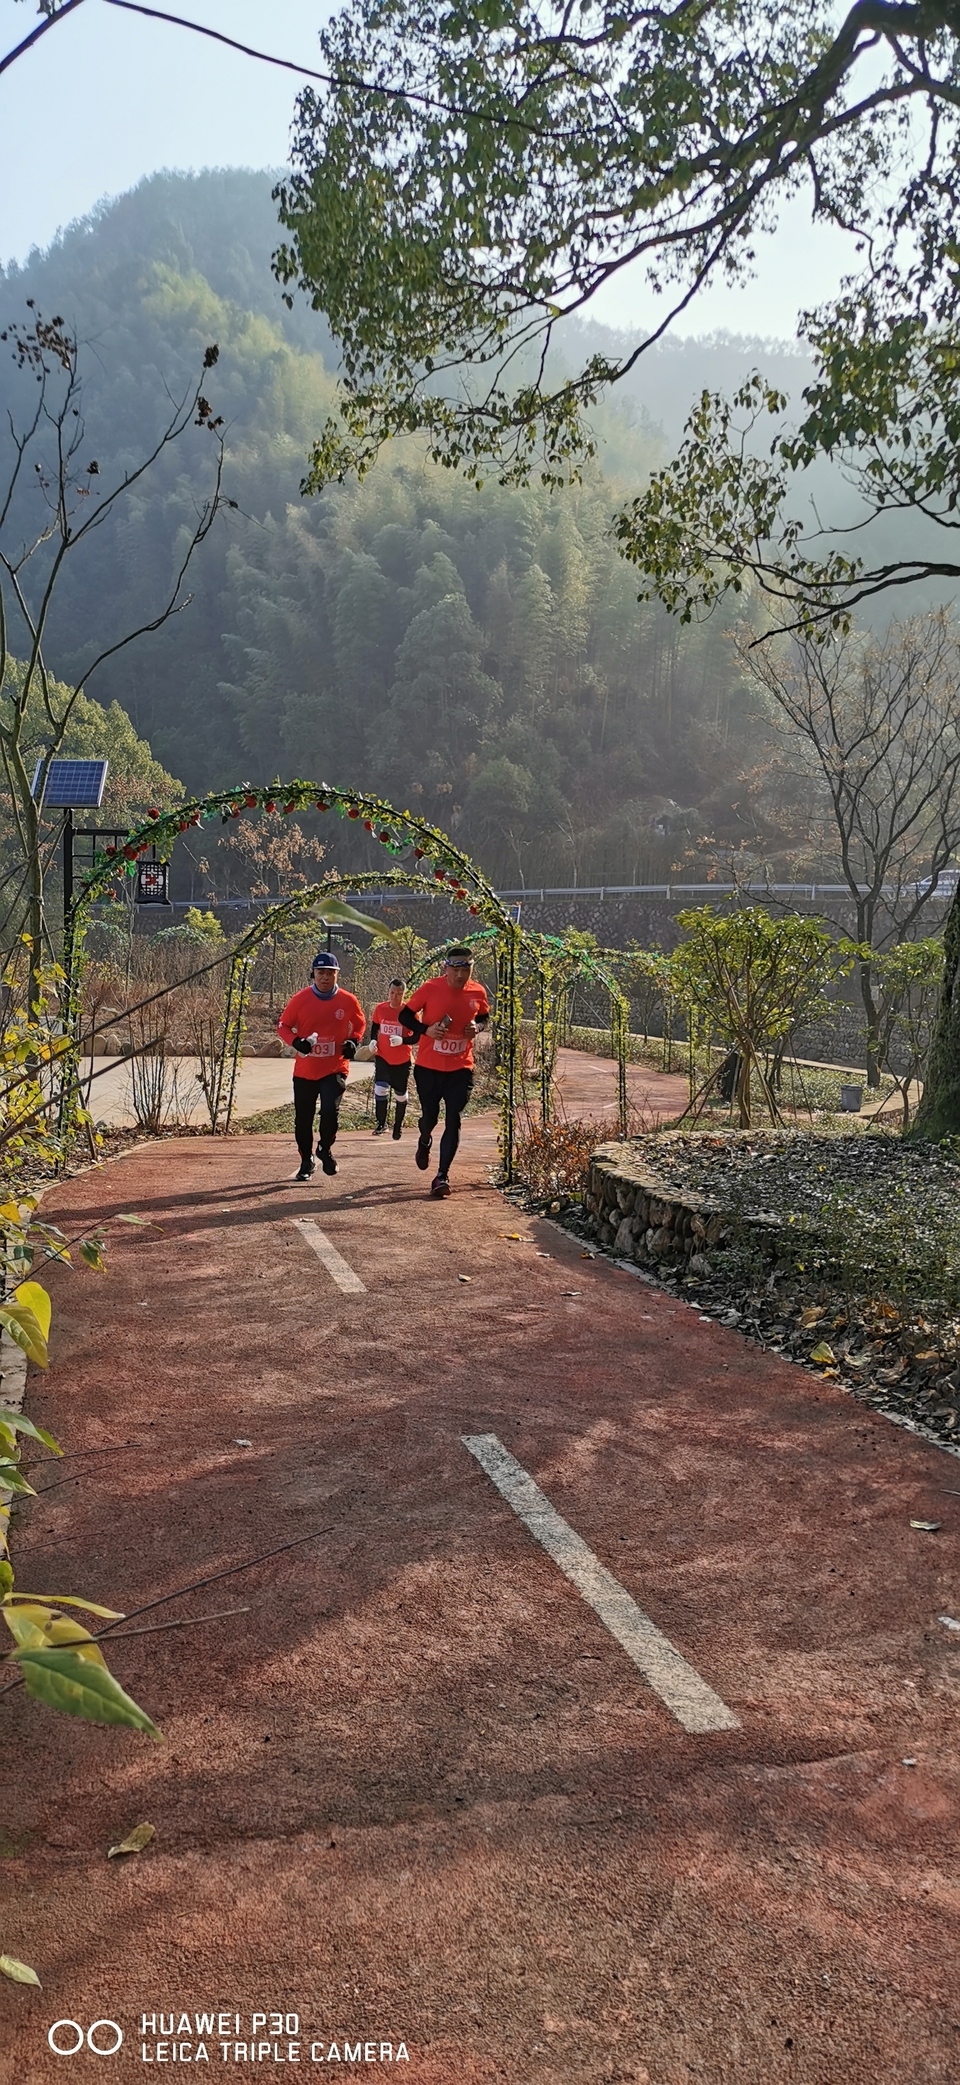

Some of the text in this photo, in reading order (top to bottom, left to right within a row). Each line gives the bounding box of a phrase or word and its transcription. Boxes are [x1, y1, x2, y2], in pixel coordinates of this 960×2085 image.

[383, 1025, 398, 1034] 051
[311, 1044, 329, 1055] 03
[441, 1040, 463, 1052] 001
